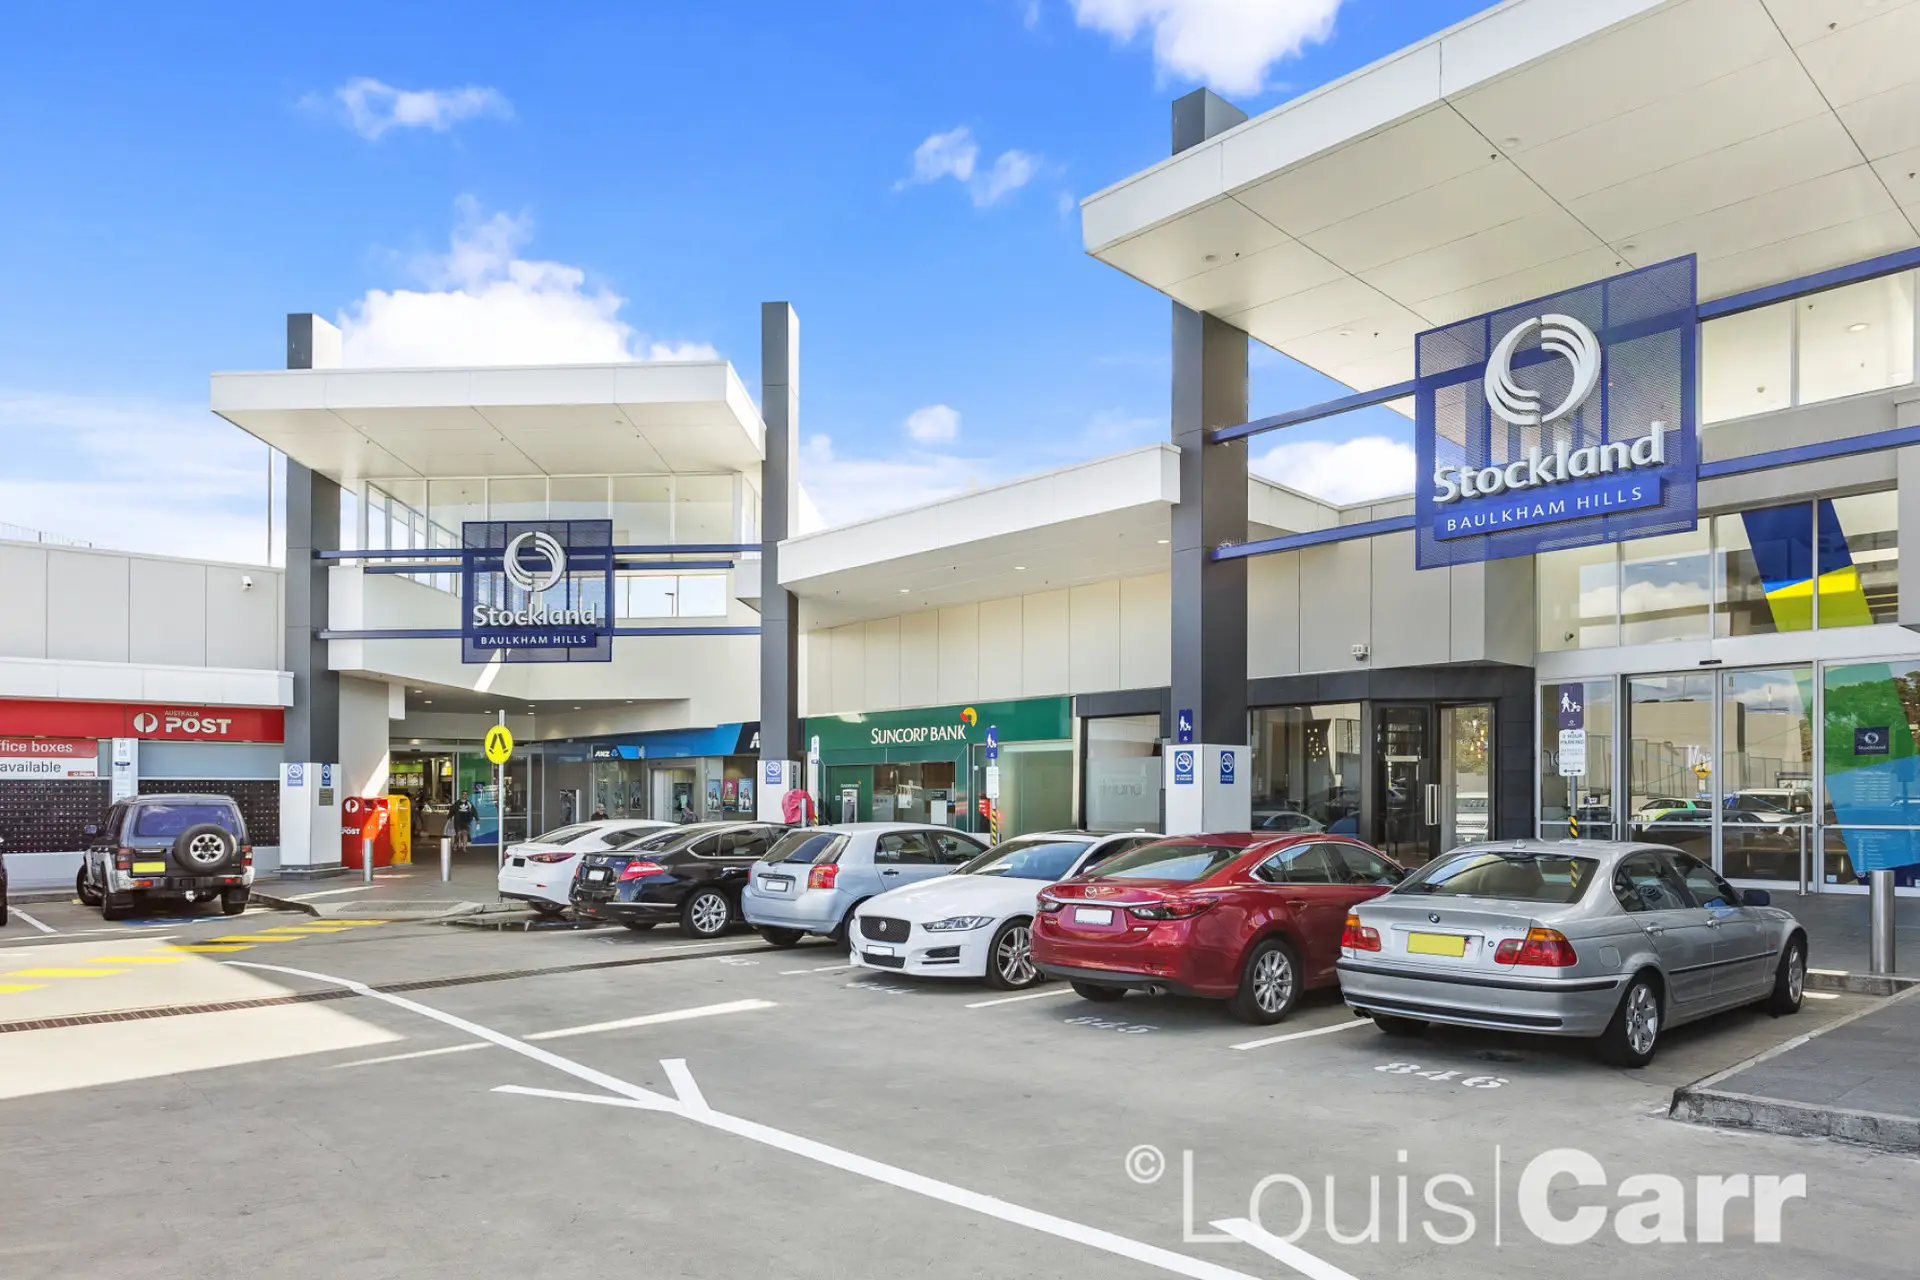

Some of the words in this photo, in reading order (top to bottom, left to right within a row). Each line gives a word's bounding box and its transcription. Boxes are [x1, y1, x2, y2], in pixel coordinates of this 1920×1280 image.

[1433, 421, 1664, 503] Stockland
[1446, 499, 1566, 532] BAULKHAM
[1577, 486, 1643, 510] HILLS
[473, 600, 597, 626] Stockland
[481, 635, 548, 645] BAULKHAM
[553, 635, 587, 644] HILLS
[165, 717, 232, 734] POST
[871, 727, 928, 744] SUNCORP
[930, 724, 967, 741] BANK
[0, 740, 27, 752] fice
[32, 740, 73, 752] boxes
[595, 750, 610, 758] ANZ
[0, 761, 61, 773] available
